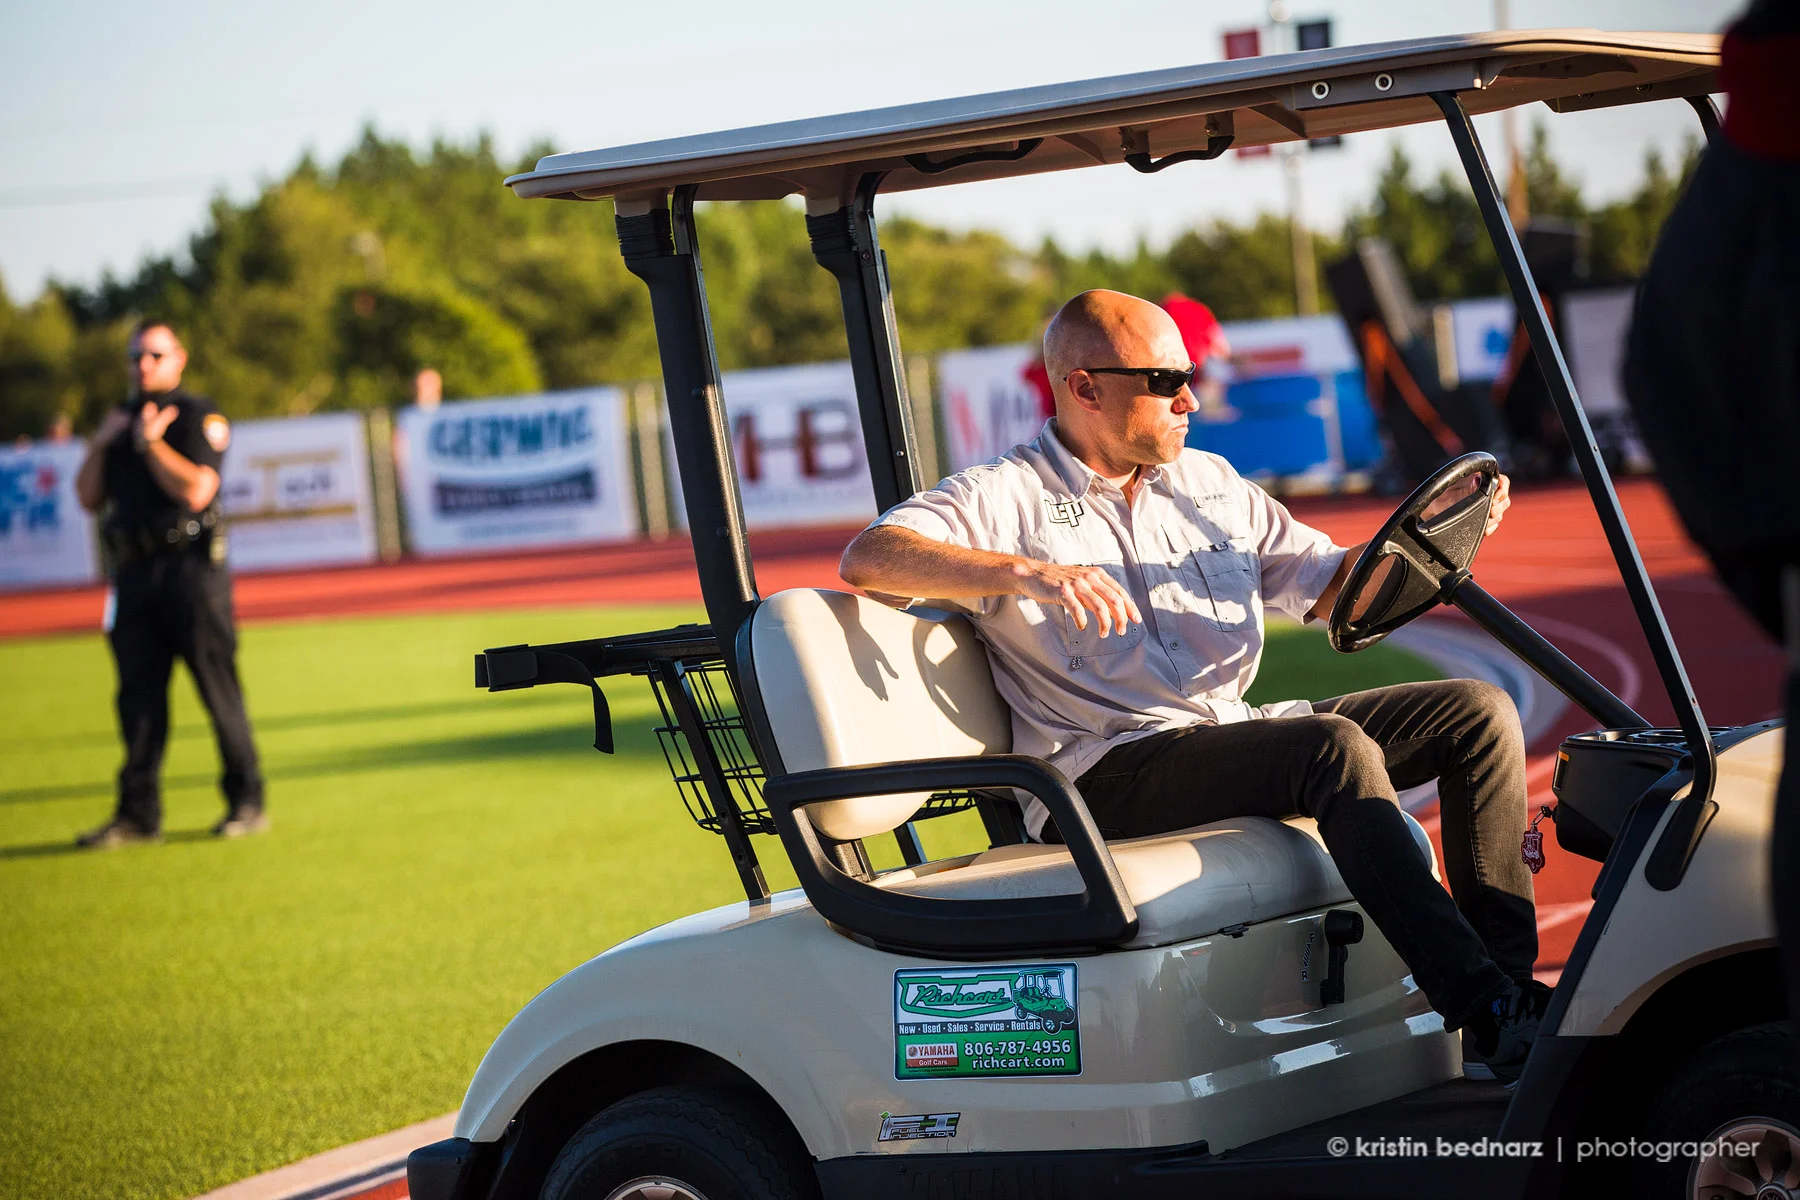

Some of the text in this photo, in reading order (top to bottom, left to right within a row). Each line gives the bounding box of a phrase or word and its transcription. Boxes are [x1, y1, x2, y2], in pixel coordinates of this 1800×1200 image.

[910, 984, 1010, 1007] Richcart
[899, 1020, 1041, 1034] New Used Sales Service Rentals
[917, 1045, 955, 1056] YAMAHA
[964, 1040, 1071, 1056] 806-787-4956
[972, 1056, 1065, 1069] richcart.com
